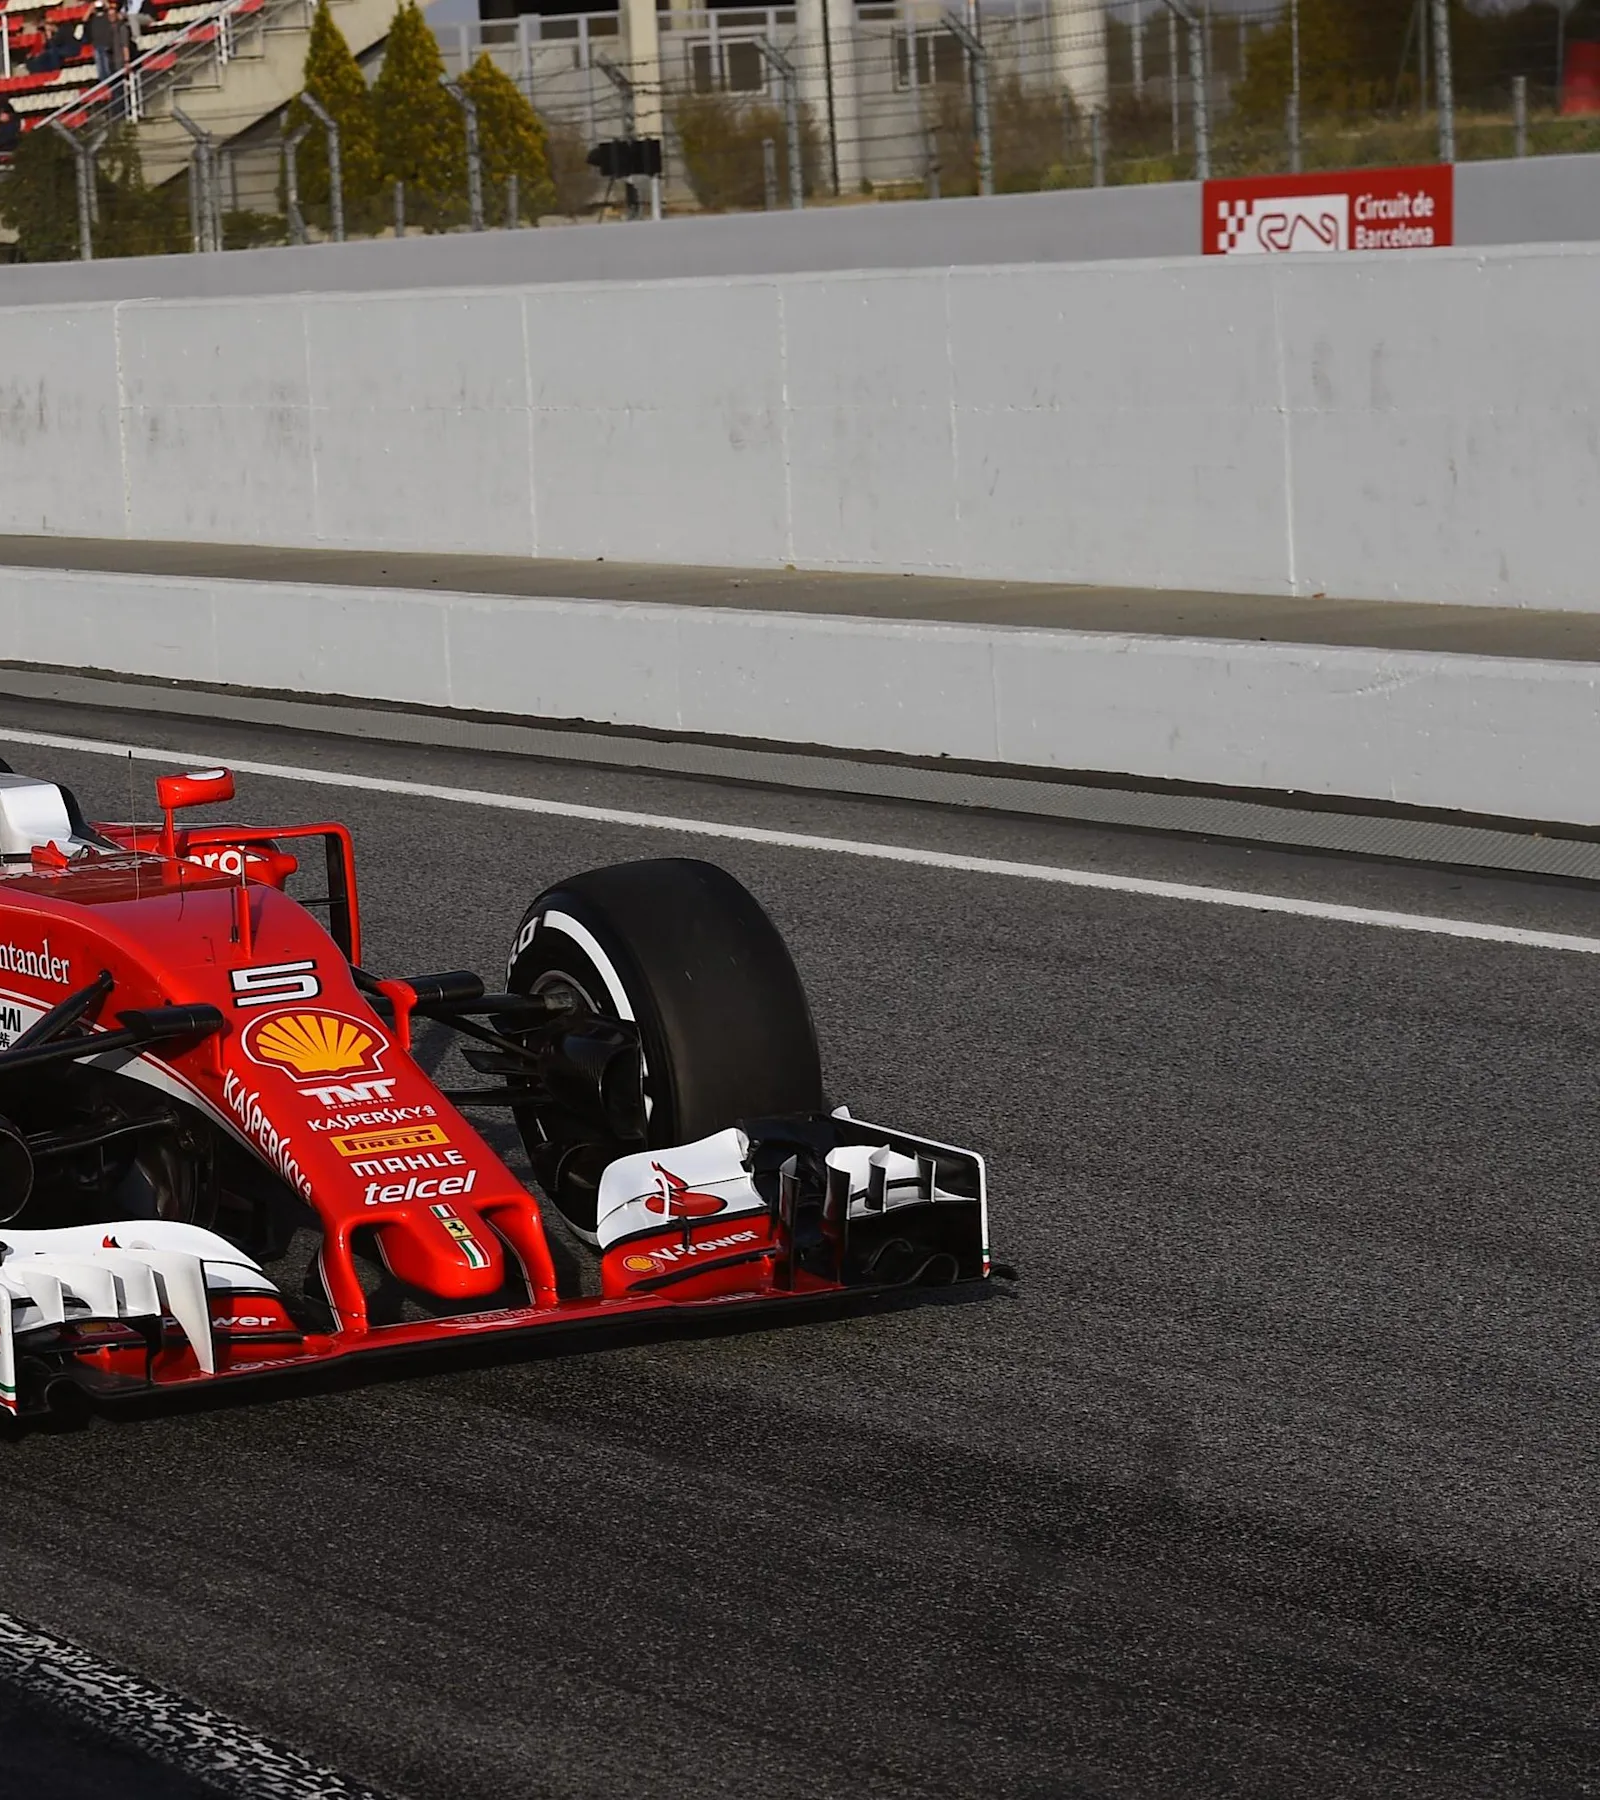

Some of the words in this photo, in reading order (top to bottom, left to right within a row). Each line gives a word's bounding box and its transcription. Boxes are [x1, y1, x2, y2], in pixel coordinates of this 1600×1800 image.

[1355, 193, 1410, 219] Circuit
[1412, 190, 1434, 217] de
[1355, 222, 1434, 248] Barcelona
[231, 960, 320, 1006] 5
[297, 1077, 397, 1106] TNT
[223, 1068, 306, 1193] KASPERSKY
[306, 1106, 422, 1132] KASPERSKY
[342, 1129, 436, 1151] PIRELLI
[349, 1149, 467, 1178] MAHLE
[364, 1169, 477, 1206] telcel
